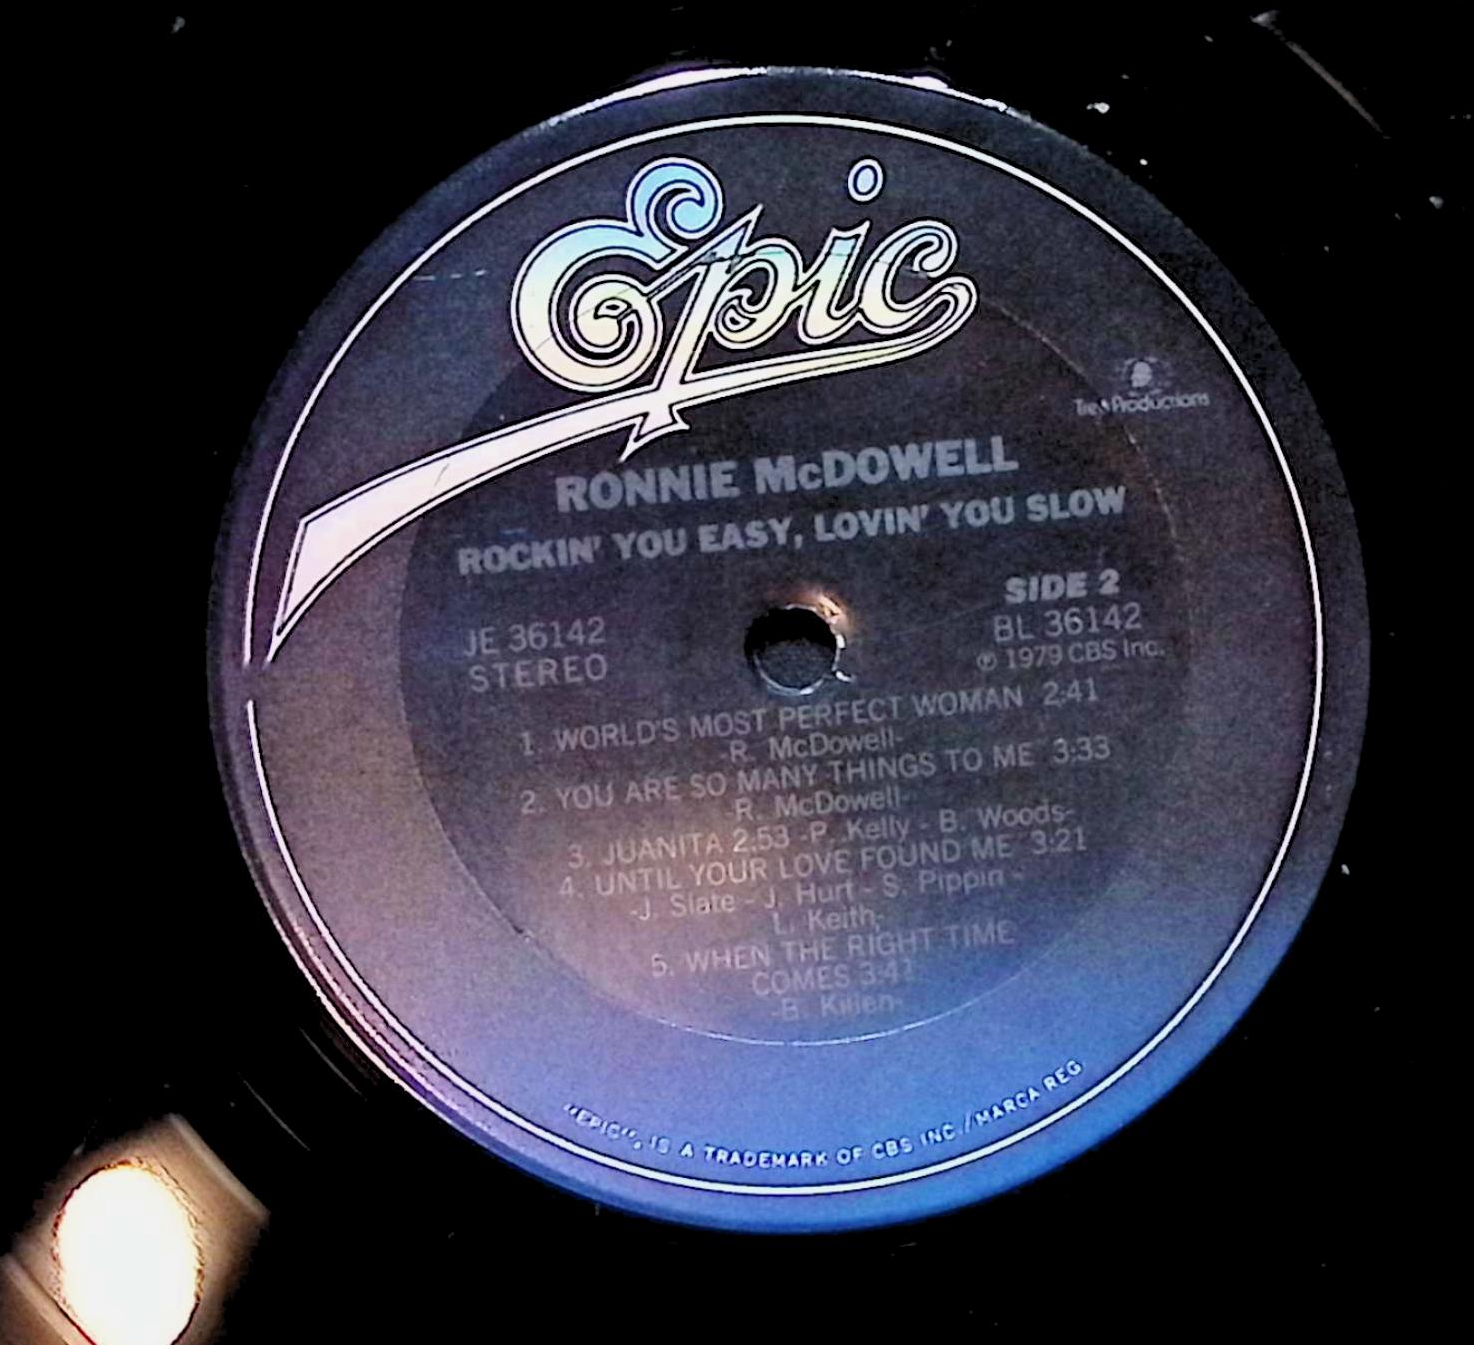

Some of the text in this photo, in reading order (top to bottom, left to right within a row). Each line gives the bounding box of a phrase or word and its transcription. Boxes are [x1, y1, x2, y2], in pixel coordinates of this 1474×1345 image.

[511, 155, 979, 461] Epic
[555, 435, 1019, 513] RONNIE McDOWELL
[457, 485, 1127, 576] ROCKIN' YOU EASY, LOVIN' YOU SLOW
[1004, 568, 1121, 605] SIDE 2
[463, 616, 606, 657] JE 36142
[993, 602, 1143, 643] BL 36142
[468, 654, 608, 693] STEREO
[1005, 643, 1064, 670] 1979
[1068, 639, 1118, 664] CBS
[1124, 638, 1167, 658] Inc.
[519, 677, 1099, 756] 1. WORLD'S MOST PERFECT WOMAN 2:41
[520, 735, 1111, 815] 2. YOU ARE SO MANY THINGS TO ME 3:33
[559, 827, 1089, 899] 4. UNTIL YOUR LOVE FOUND ME 3:21
[568, 843, 593, 871] 3.
[604, 832, 724, 867] JUANITA
[846, 814, 912, 844] Kelly
[938, 809, 968, 834] B.
[670, 891, 737, 918] Slate
[764, 886, 784, 910] J.
[796, 878, 854, 905] Hurt
[882, 871, 909, 898] S.
[918, 866, 1005, 896] Pippin
[651, 919, 1017, 979] 5. WHEN THE RIGHT TIME
[751, 963, 850, 997] COMES
[680, 1143, 694, 1158] A
[704, 1144, 827, 1168] TRADEMARK
[837, 1147, 864, 1165] OF
[871, 1136, 913, 1159] CBS
